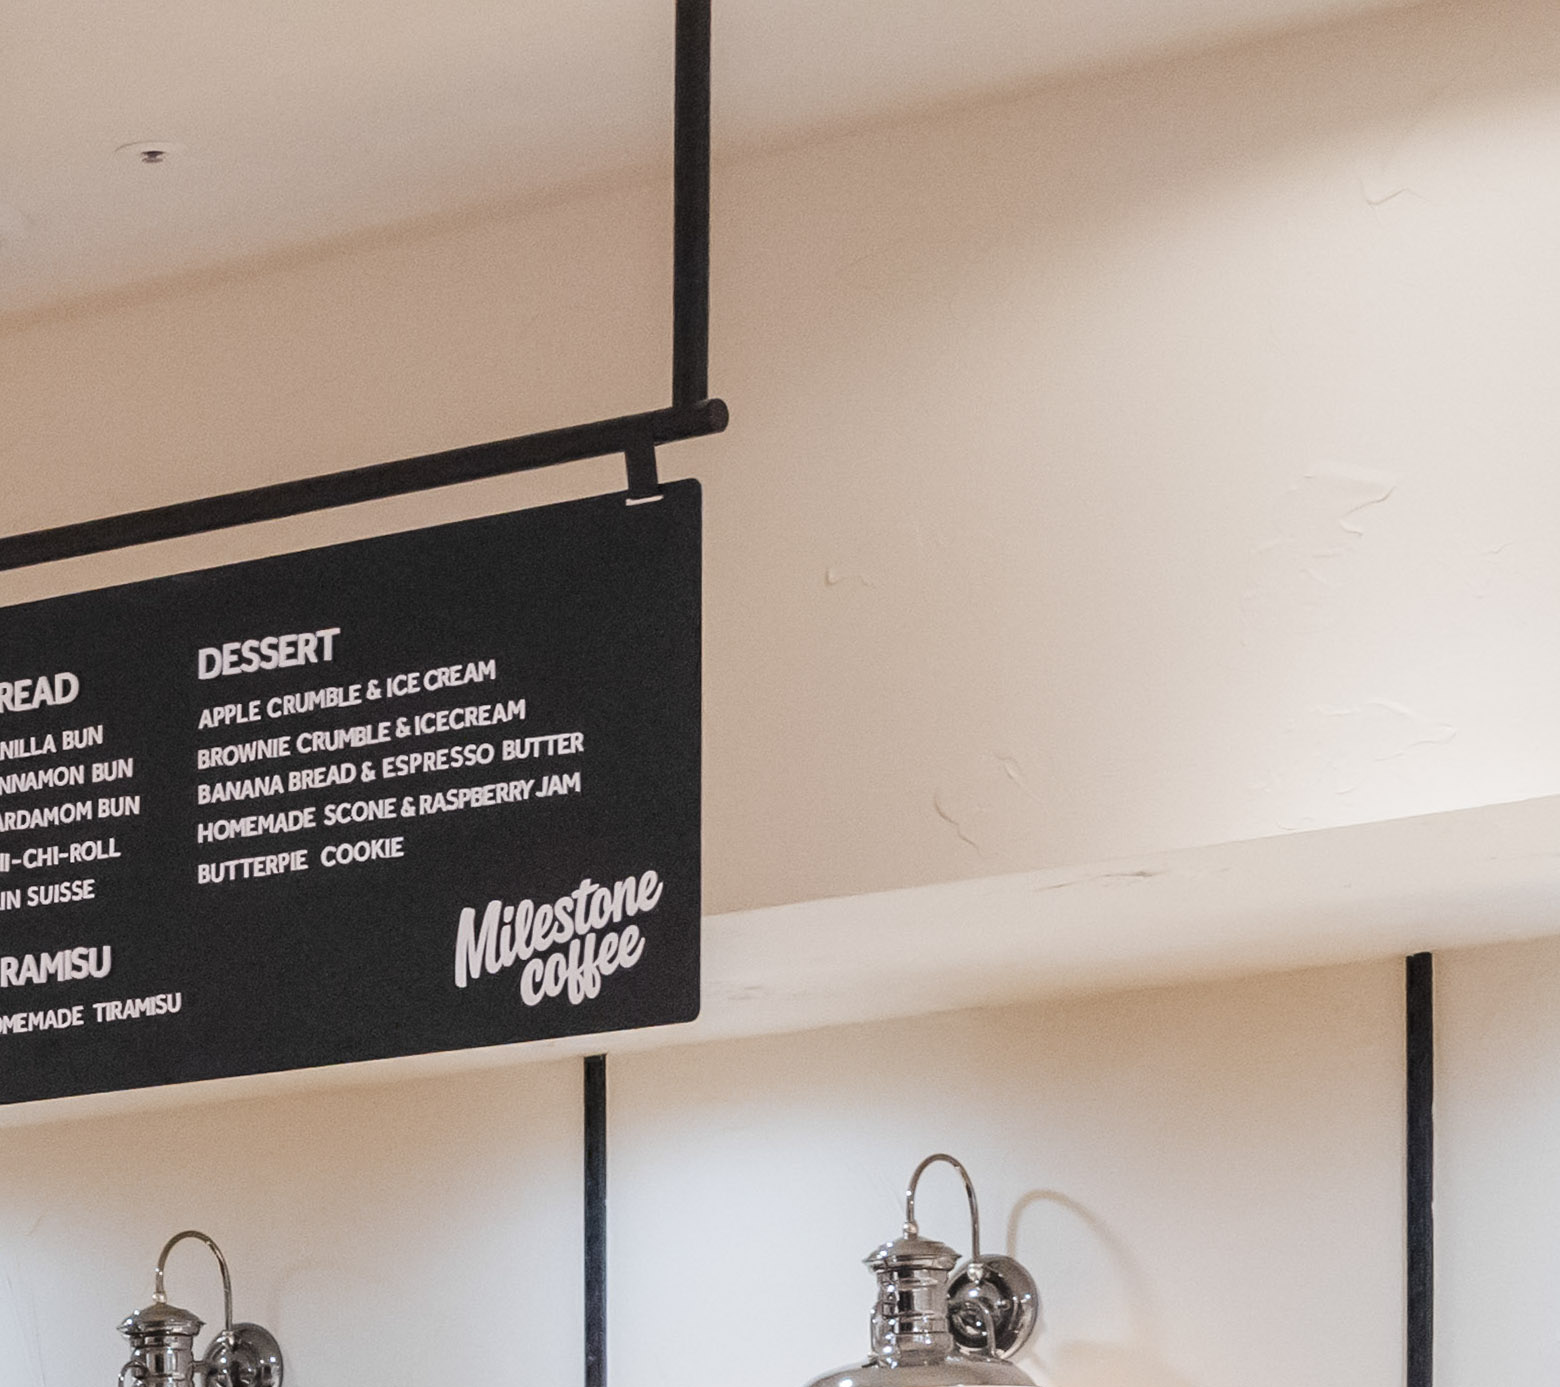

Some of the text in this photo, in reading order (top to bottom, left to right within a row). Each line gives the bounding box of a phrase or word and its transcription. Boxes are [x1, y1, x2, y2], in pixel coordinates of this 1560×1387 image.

[197, 627, 341, 680] DESSERT
[197, 659, 497, 730] APPLE CRUMBLE & ICE CREAM
[62, 724, 104, 751] BUN
[197, 698, 526, 770] BROWNIE CRUMBLE & ICECREAM
[91, 757, 134, 783] BUN
[197, 731, 585, 805] BANANA BREAD & ESPRESSO BUTTER
[97, 795, 141, 819] BUN
[197, 771, 582, 844] HOMEMADE SCONE & RASPBERRY JAM
[197, 836, 405, 885] BUTTERPIE COOKIE
[27, 878, 96, 907] SUISSE
[455, 870, 663, 988] Milestone
[520, 924, 646, 1006] coffee
[92, 992, 182, 1023] TIRAMISU
